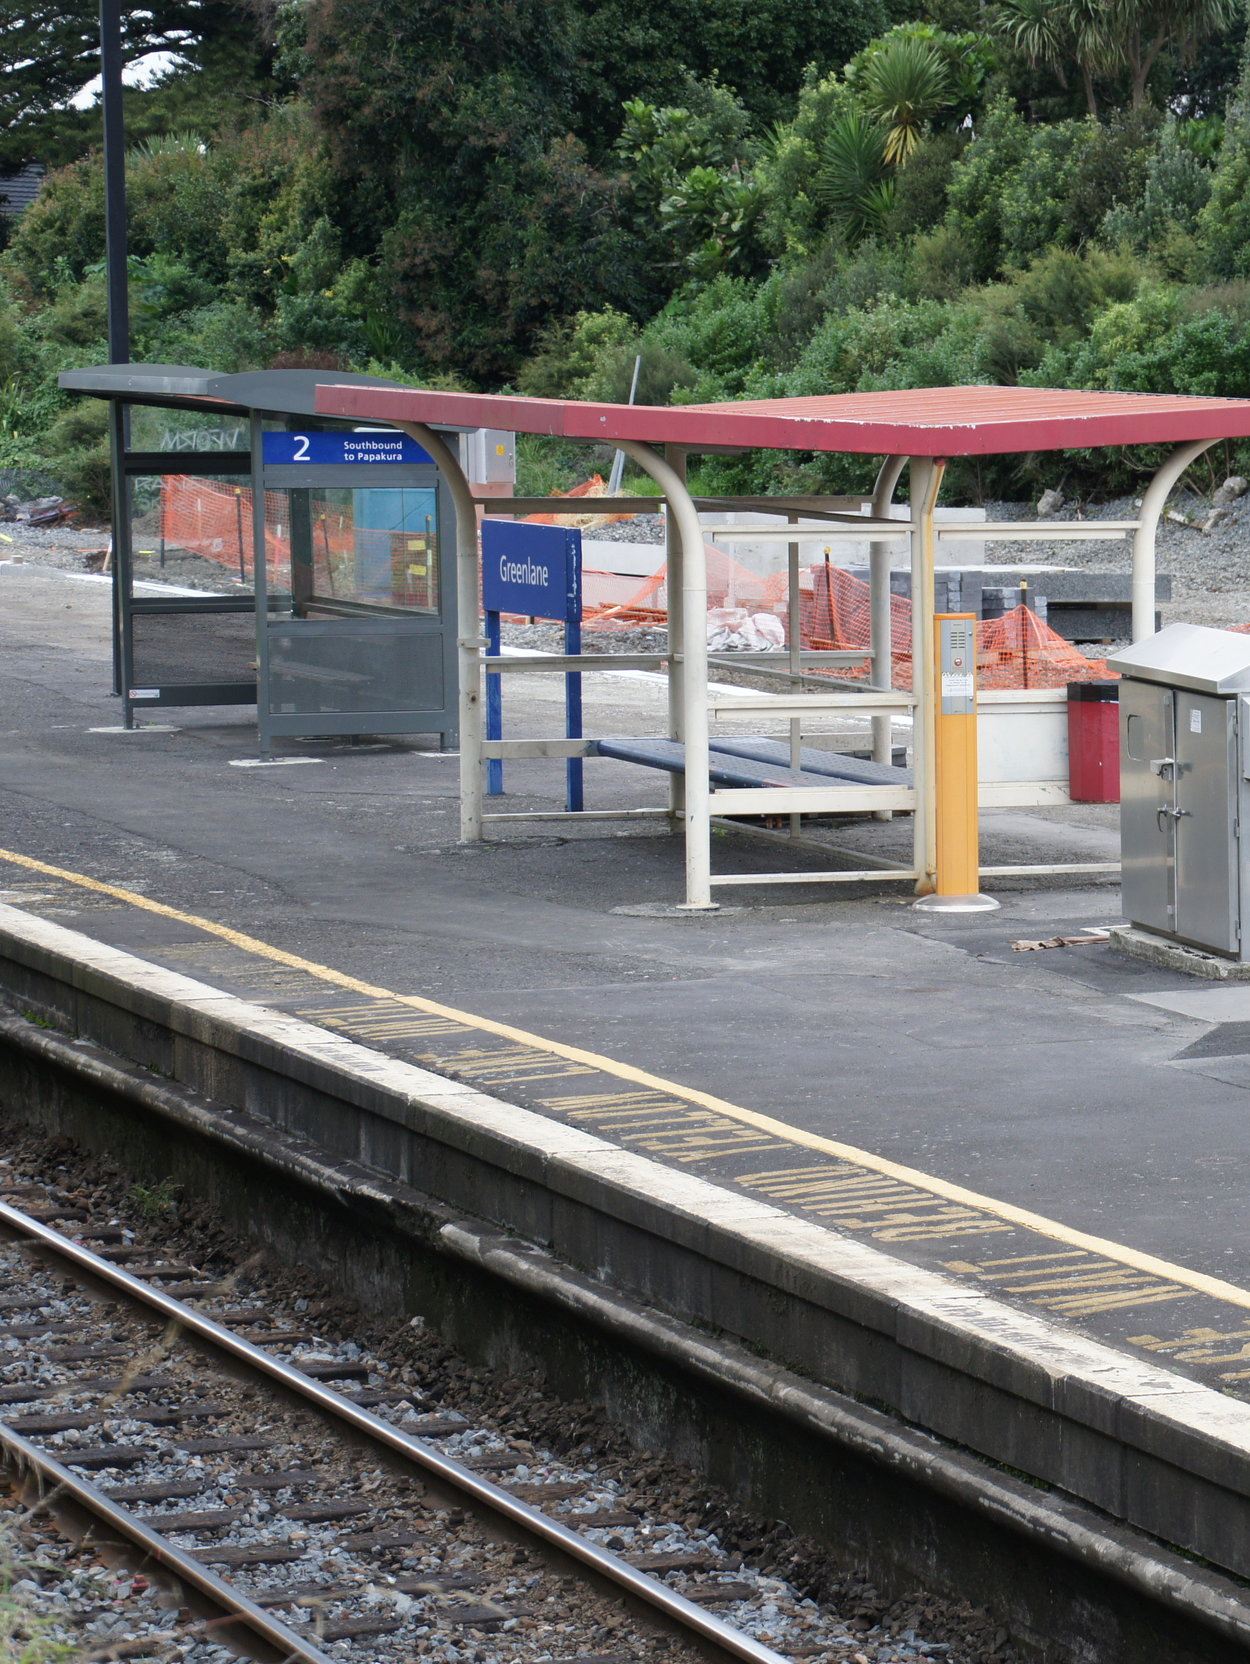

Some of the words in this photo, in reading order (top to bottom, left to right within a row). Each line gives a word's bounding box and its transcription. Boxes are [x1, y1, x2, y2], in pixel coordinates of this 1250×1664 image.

[293, 436, 310, 461] 2
[344, 441, 402, 450] Southbound
[344, 453, 355, 461] to
[357, 452, 402, 462] Papakura
[499, 554, 549, 587] Greenlane
[414, 1045, 602, 1085] LINE
[532, 1091, 797, 1163] YELLOW
[733, 1164, 1016, 1242] BEHIND
[939, 1250, 1199, 1317] WAIT
